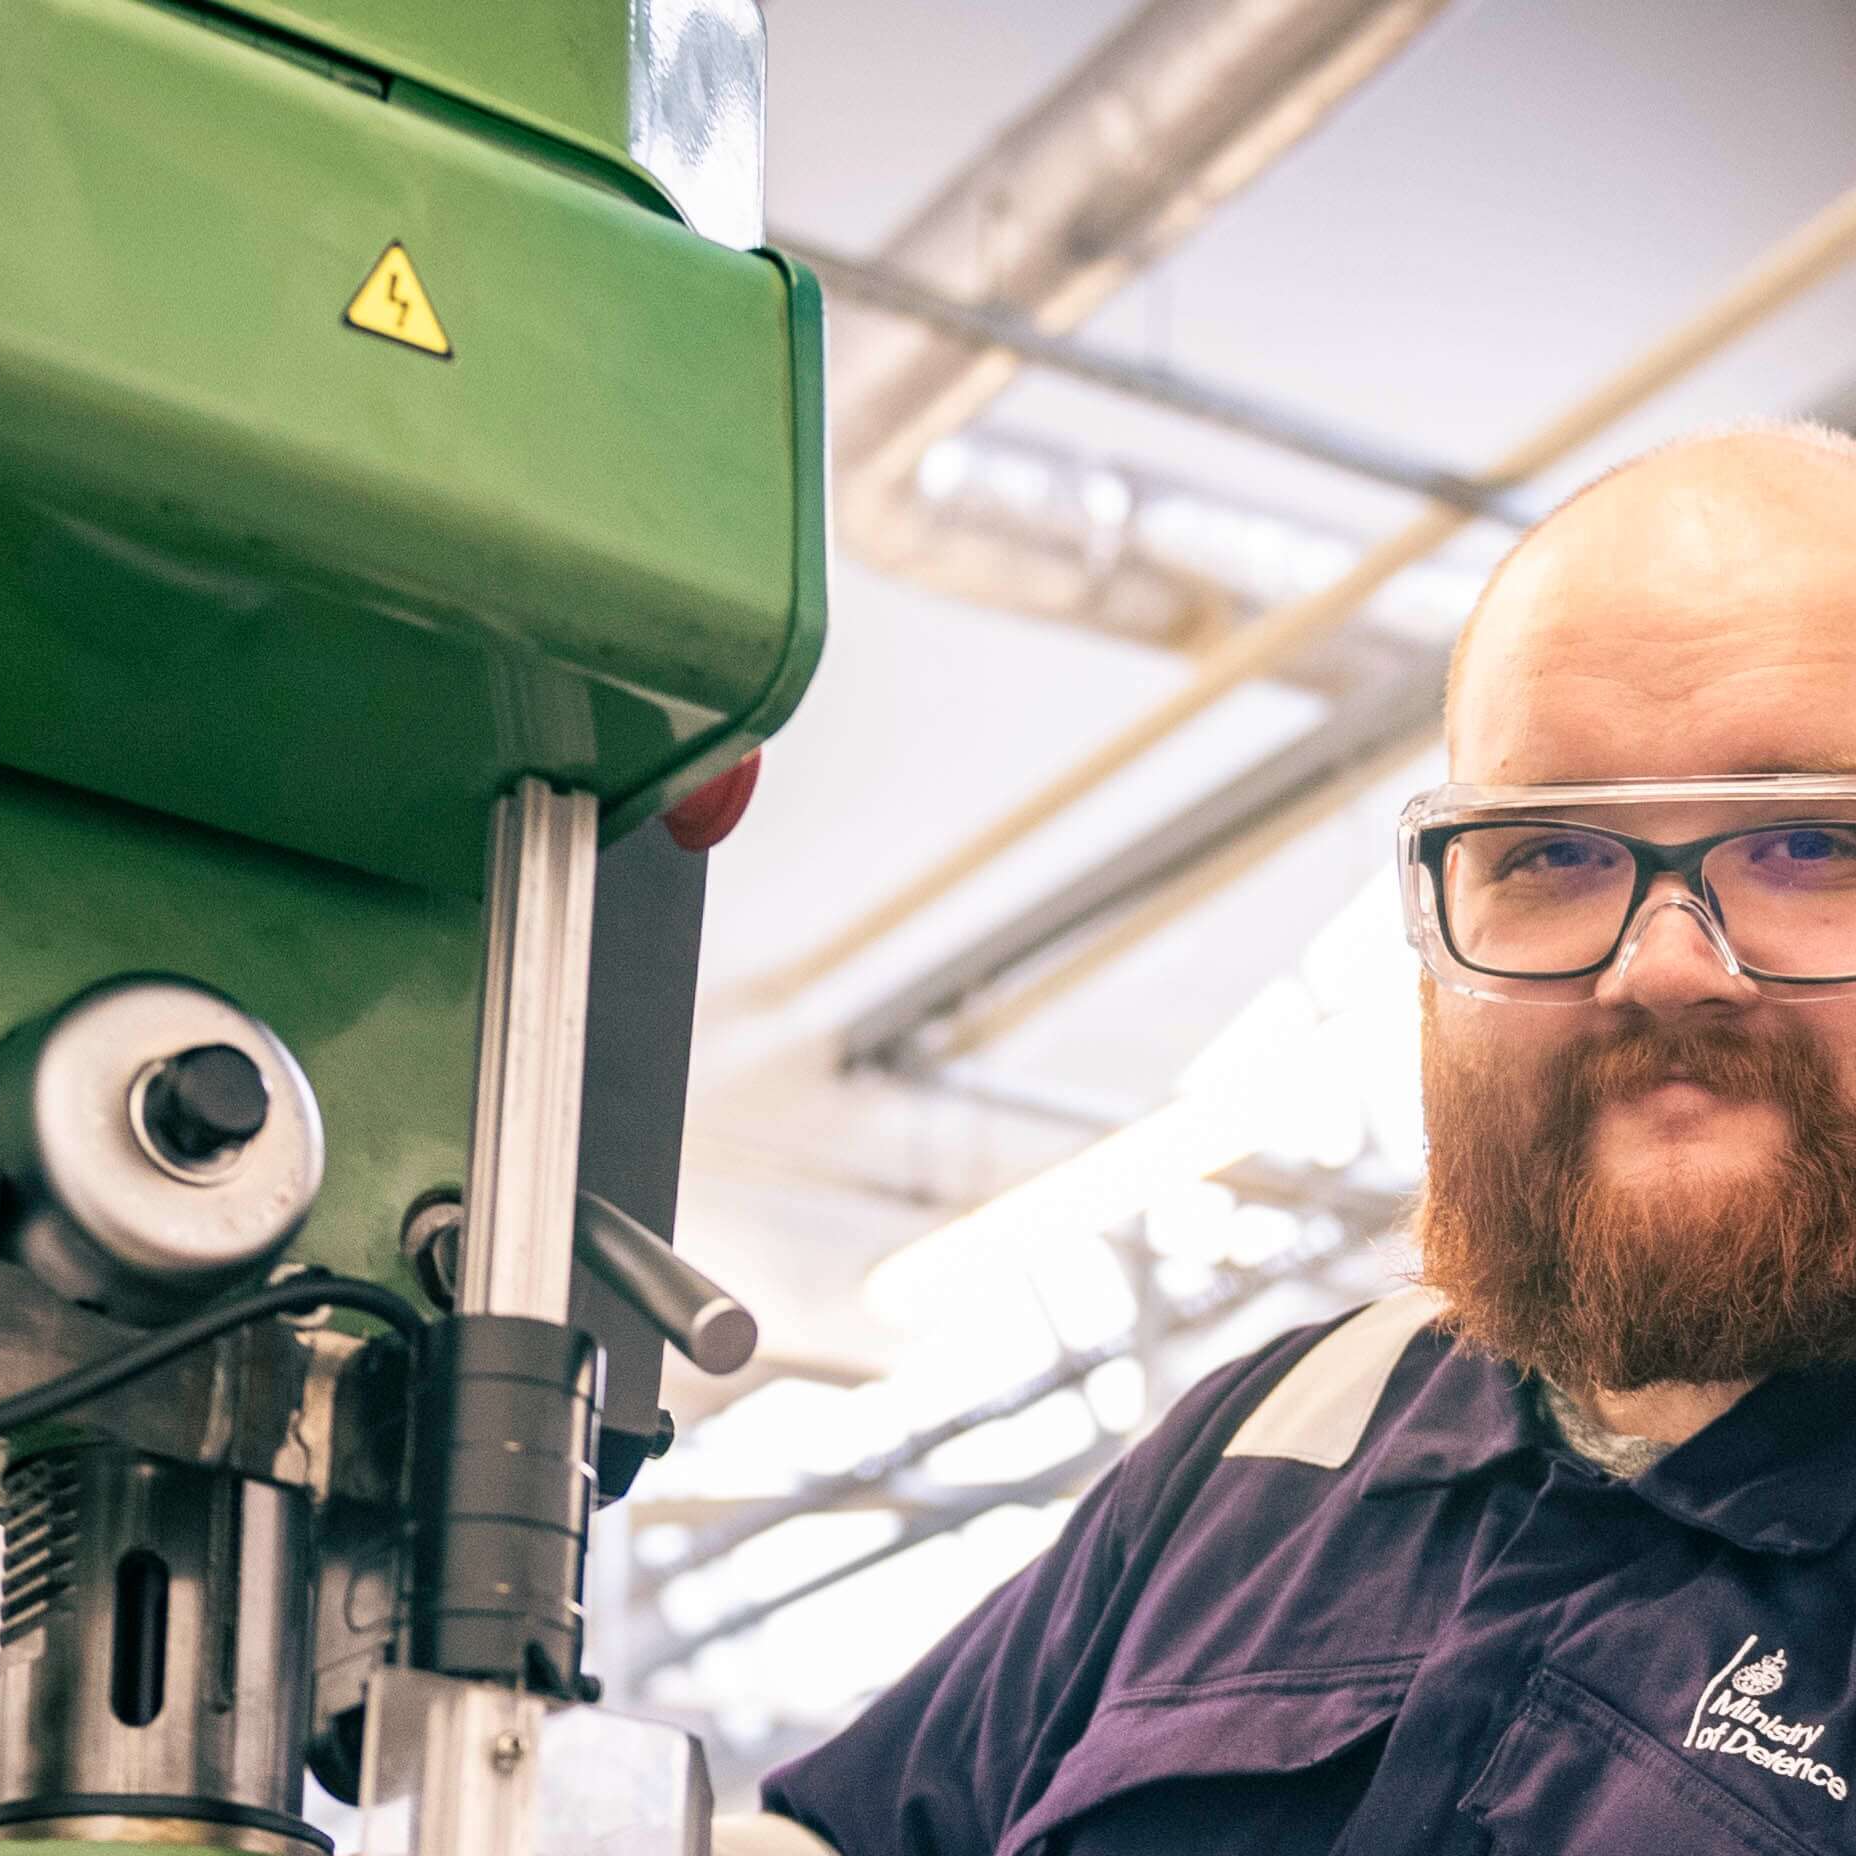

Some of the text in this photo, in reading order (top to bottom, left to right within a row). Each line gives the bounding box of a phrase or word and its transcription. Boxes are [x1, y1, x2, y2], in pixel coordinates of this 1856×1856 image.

[1708, 1688, 1825, 1753] Ministry
[1695, 1721, 1848, 1801] of Defence
